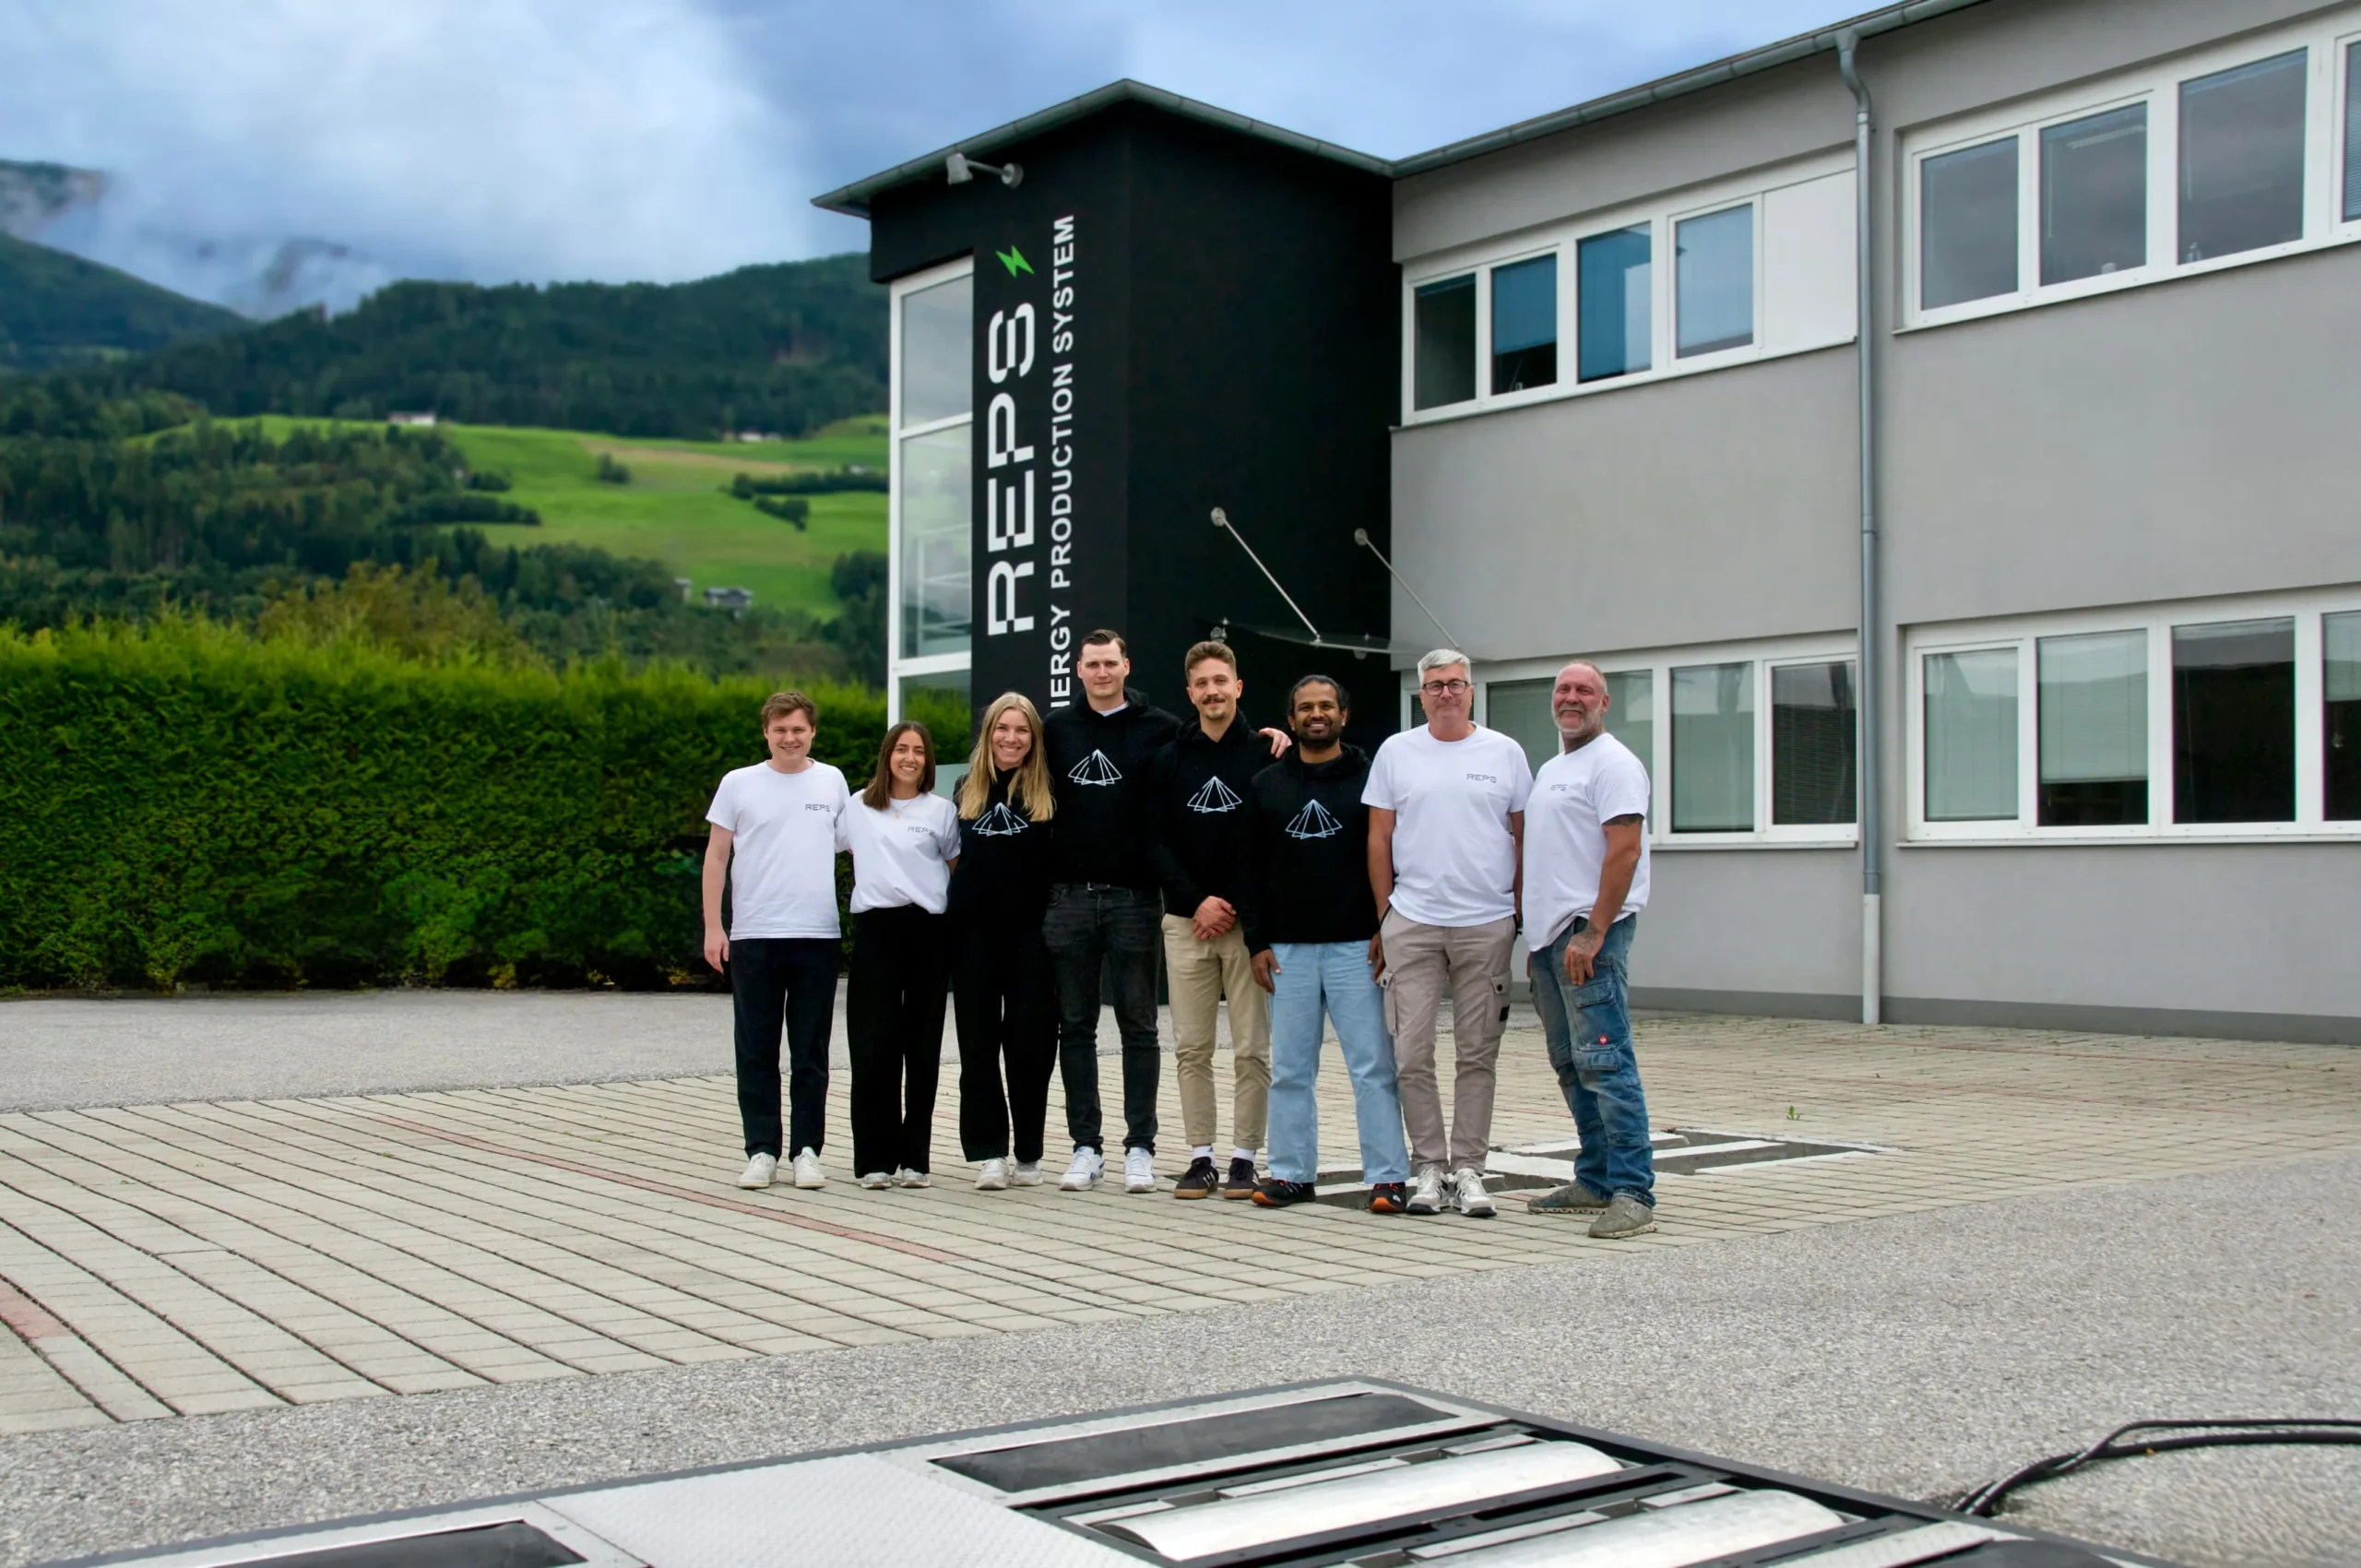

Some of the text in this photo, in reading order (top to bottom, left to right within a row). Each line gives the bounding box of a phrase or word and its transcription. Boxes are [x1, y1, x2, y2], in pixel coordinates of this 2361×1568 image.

[988, 303, 1035, 636] REPS
[1050, 216, 1074, 708] ERGY PRODUCTION SYSTEM
[1466, 773, 1497, 783] REPS
